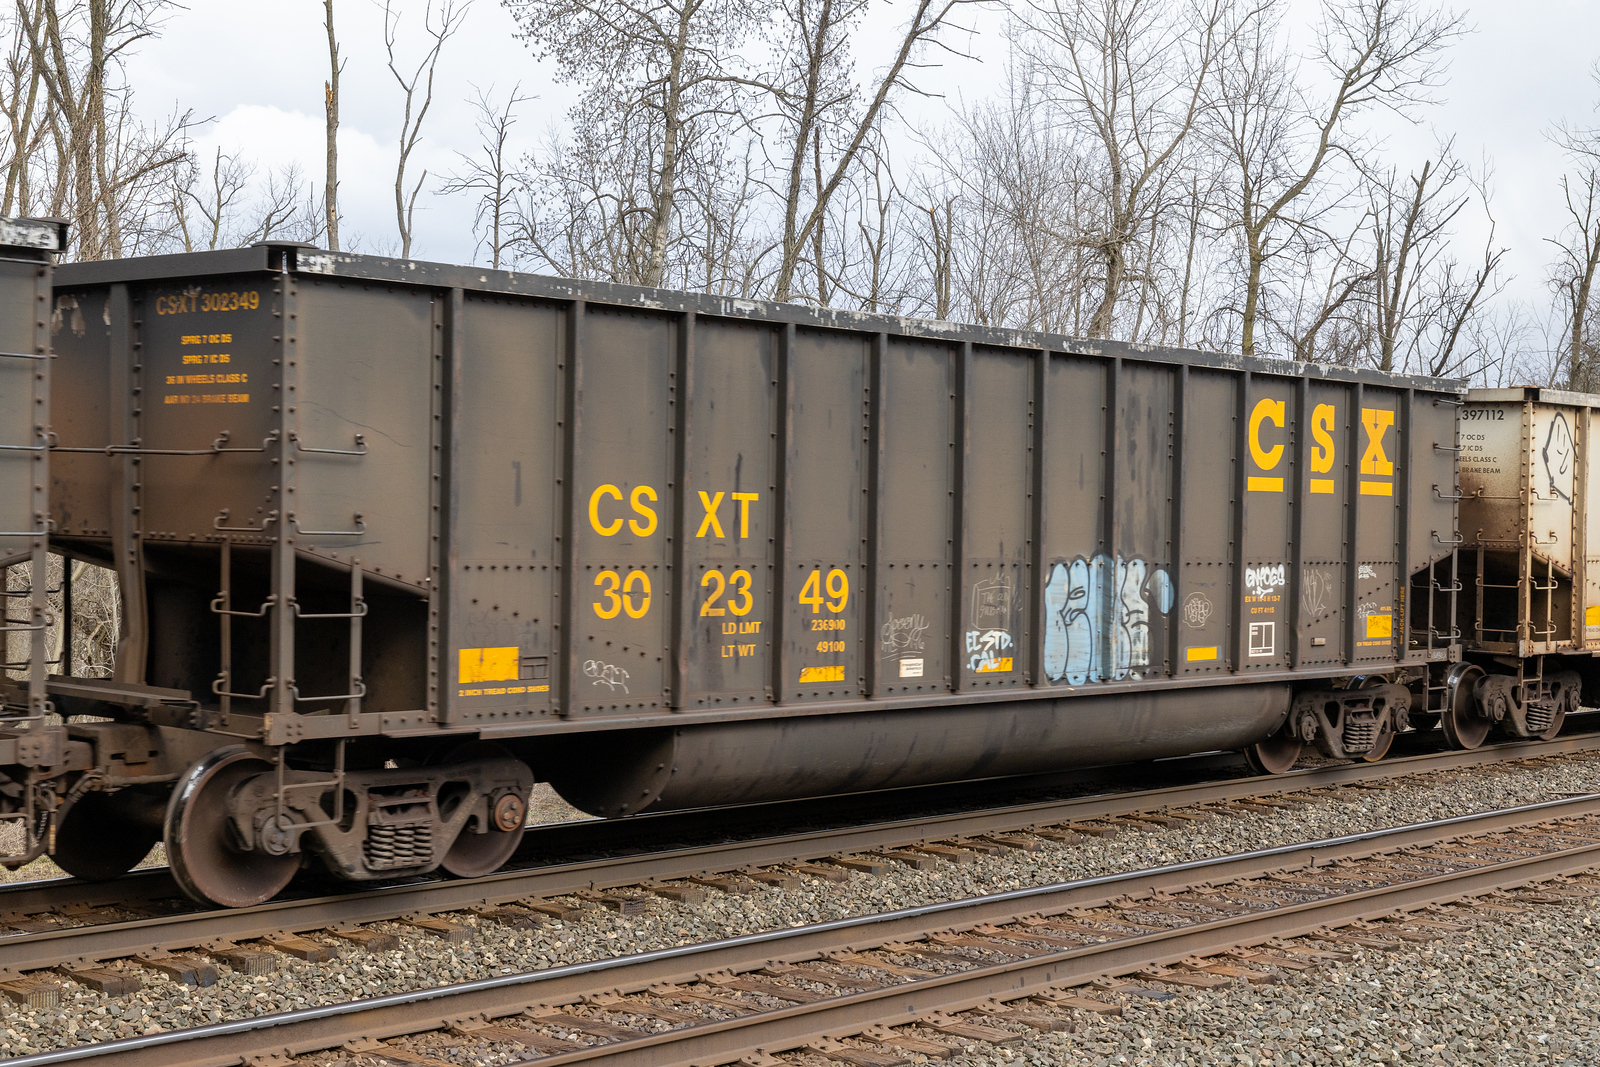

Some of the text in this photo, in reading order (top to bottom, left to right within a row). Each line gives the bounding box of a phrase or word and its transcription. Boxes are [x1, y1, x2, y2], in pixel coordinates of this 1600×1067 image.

[156, 291, 260, 315] CSXT 302349
[202, 335, 207, 344] 7
[203, 354, 208, 364] 7
[186, 374, 216, 384] WHEELS
[216, 373, 241, 383] CLASS
[240, 373, 248, 383] C
[1462, 409, 1505, 421] 397112
[721, 619, 846, 635] LD LMT 236900
[721, 641, 845, 658] LT WT 49100
